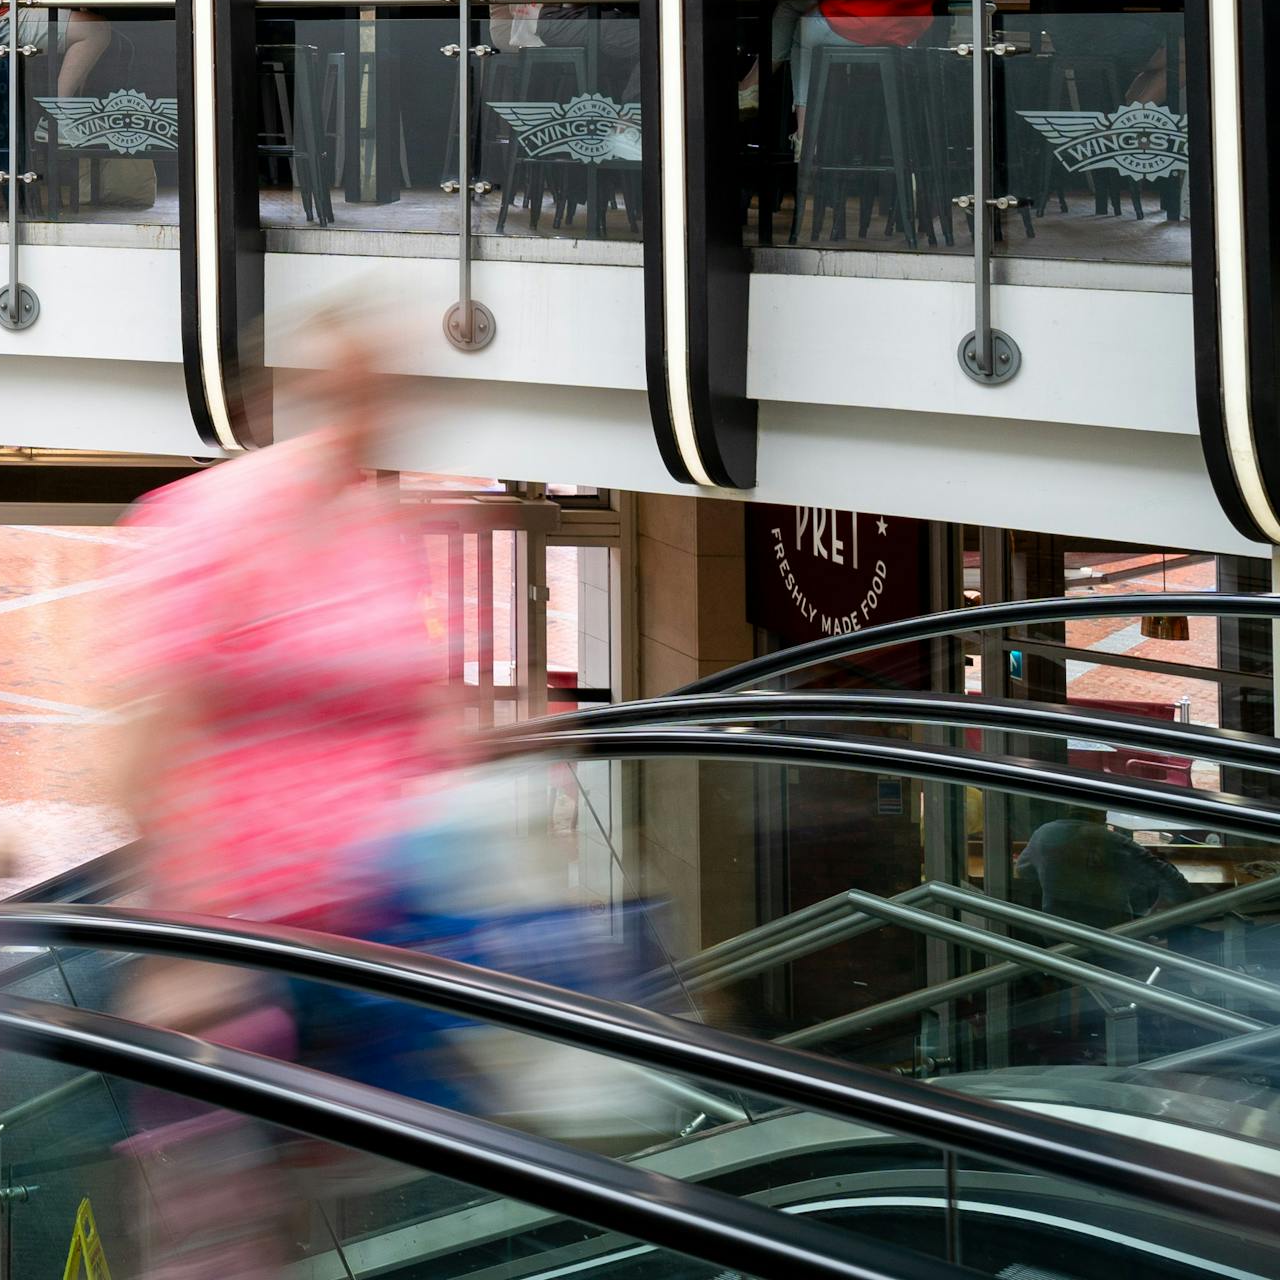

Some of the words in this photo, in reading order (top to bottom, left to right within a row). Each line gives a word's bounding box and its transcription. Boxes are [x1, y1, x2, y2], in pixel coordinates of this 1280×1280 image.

[771, 528, 817, 623] FRESHLY
[821, 612, 861, 636] MADE
[861, 560, 887, 620] FOOD
